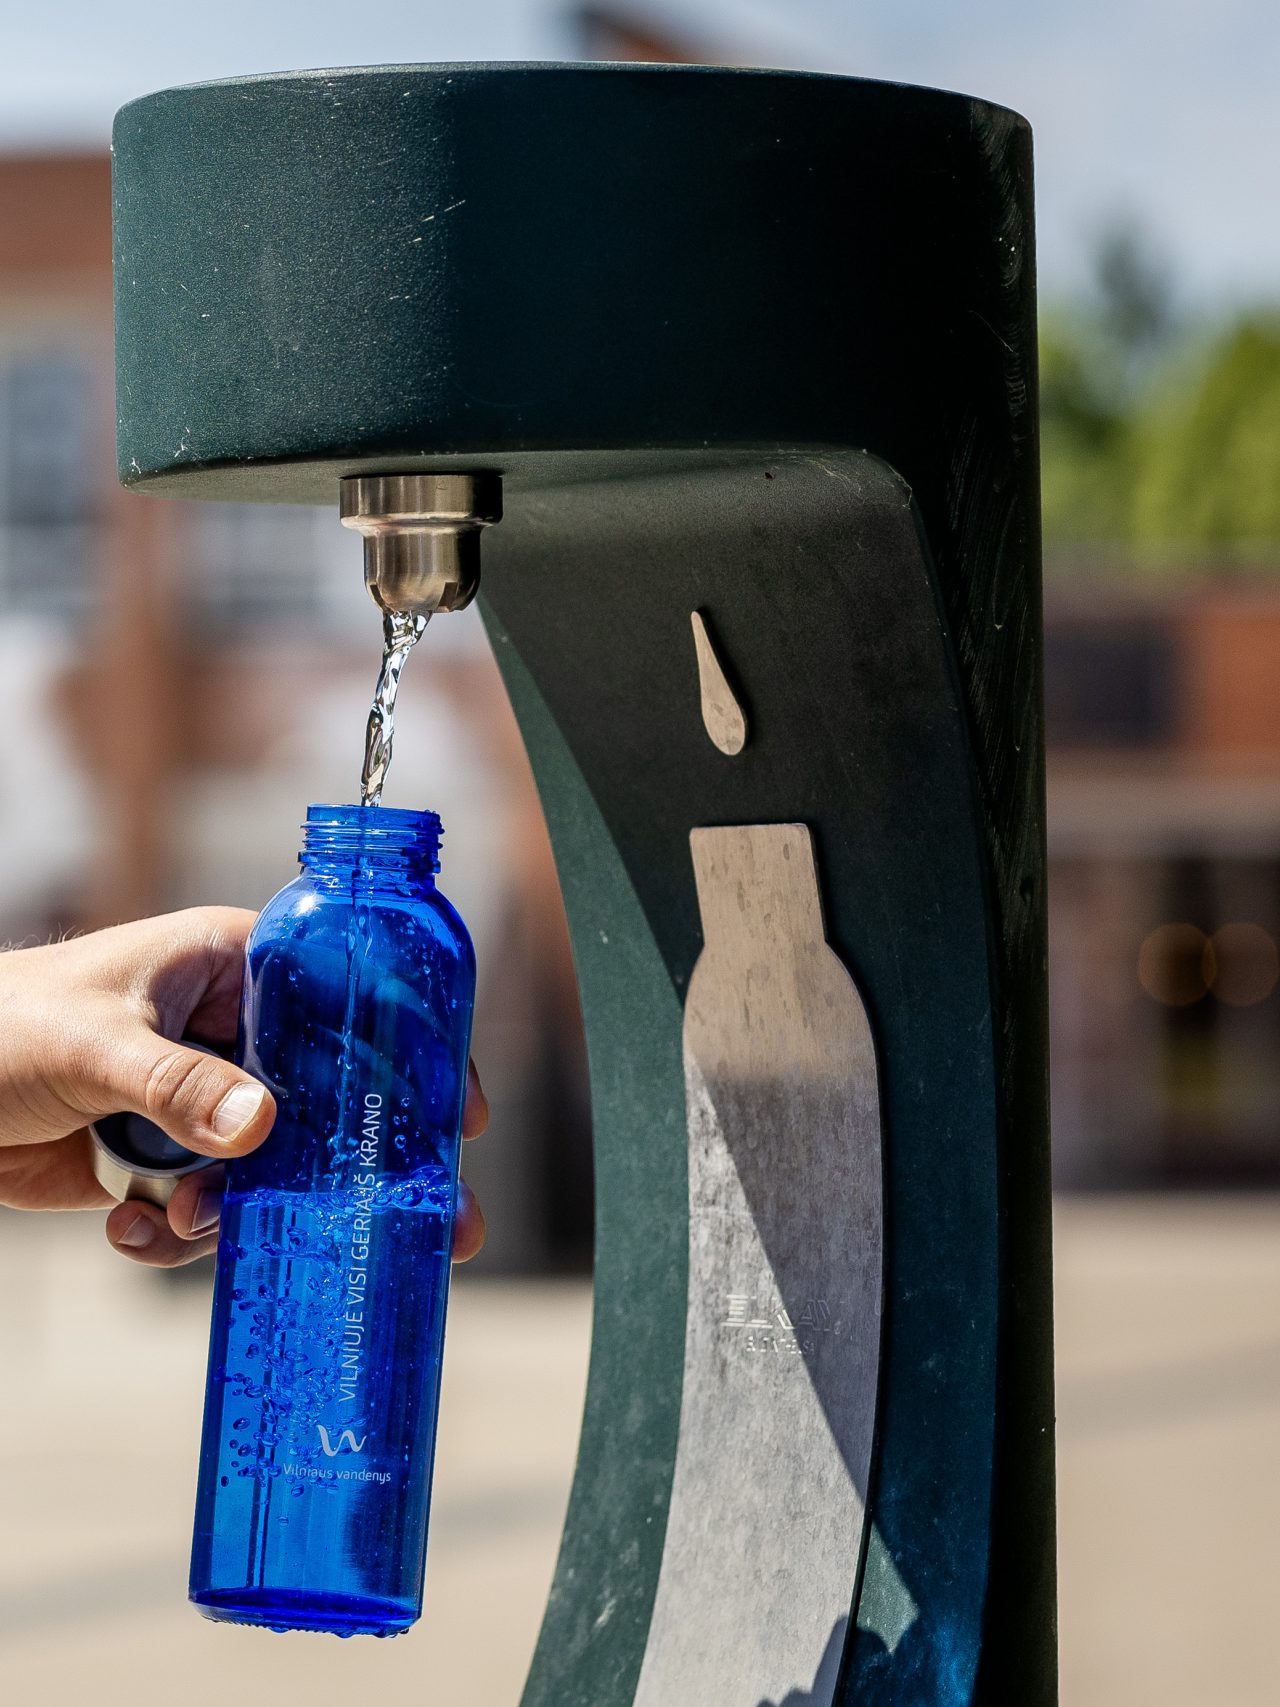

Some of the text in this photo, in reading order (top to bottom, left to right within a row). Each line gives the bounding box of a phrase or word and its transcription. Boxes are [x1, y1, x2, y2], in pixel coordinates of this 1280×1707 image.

[359, 1093, 382, 1167] KRANO
[351, 1196, 373, 1260] GERIA
[348, 1267, 368, 1305] VISI
[283, 1463, 392, 1485] Vilniaus vandenys
